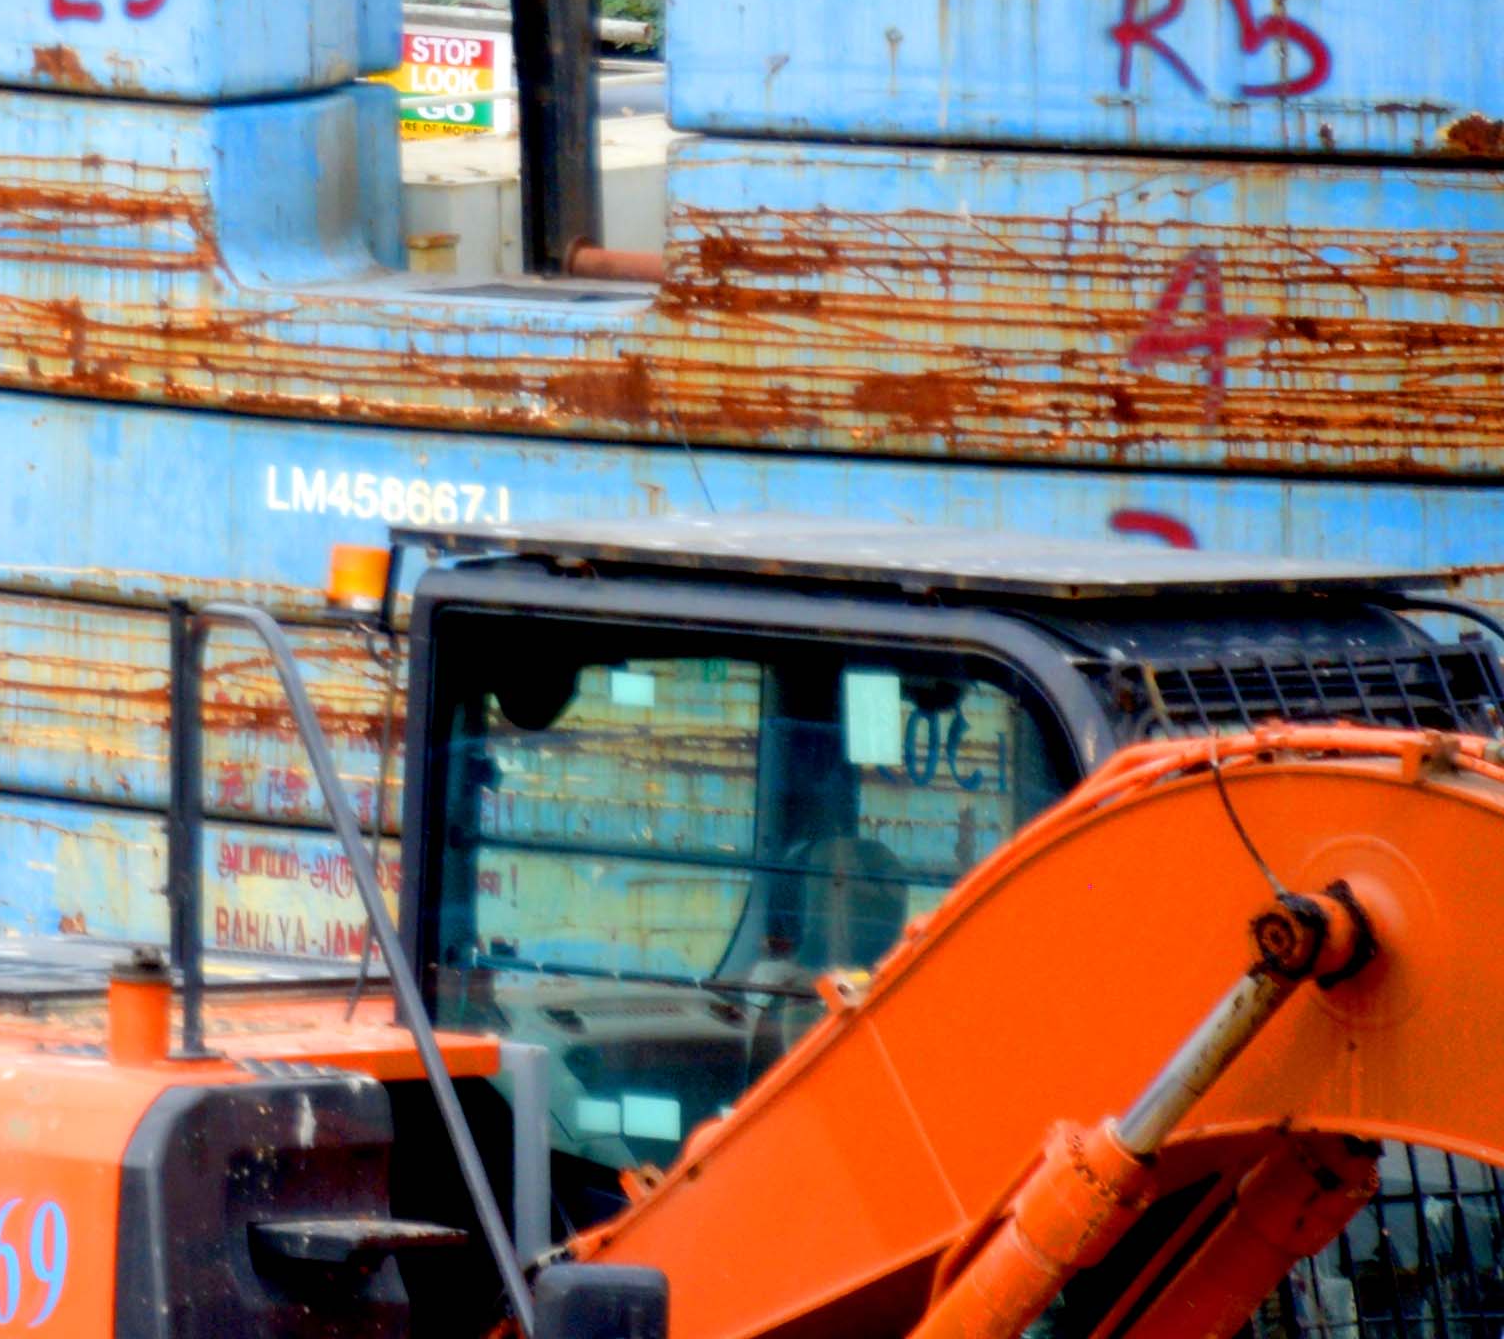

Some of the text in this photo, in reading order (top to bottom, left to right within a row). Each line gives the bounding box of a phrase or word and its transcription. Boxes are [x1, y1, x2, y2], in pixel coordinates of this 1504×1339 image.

[412, 36, 482, 65] STOP
[412, 66, 479, 93] LOOK
[417, 101, 475, 122] GO
